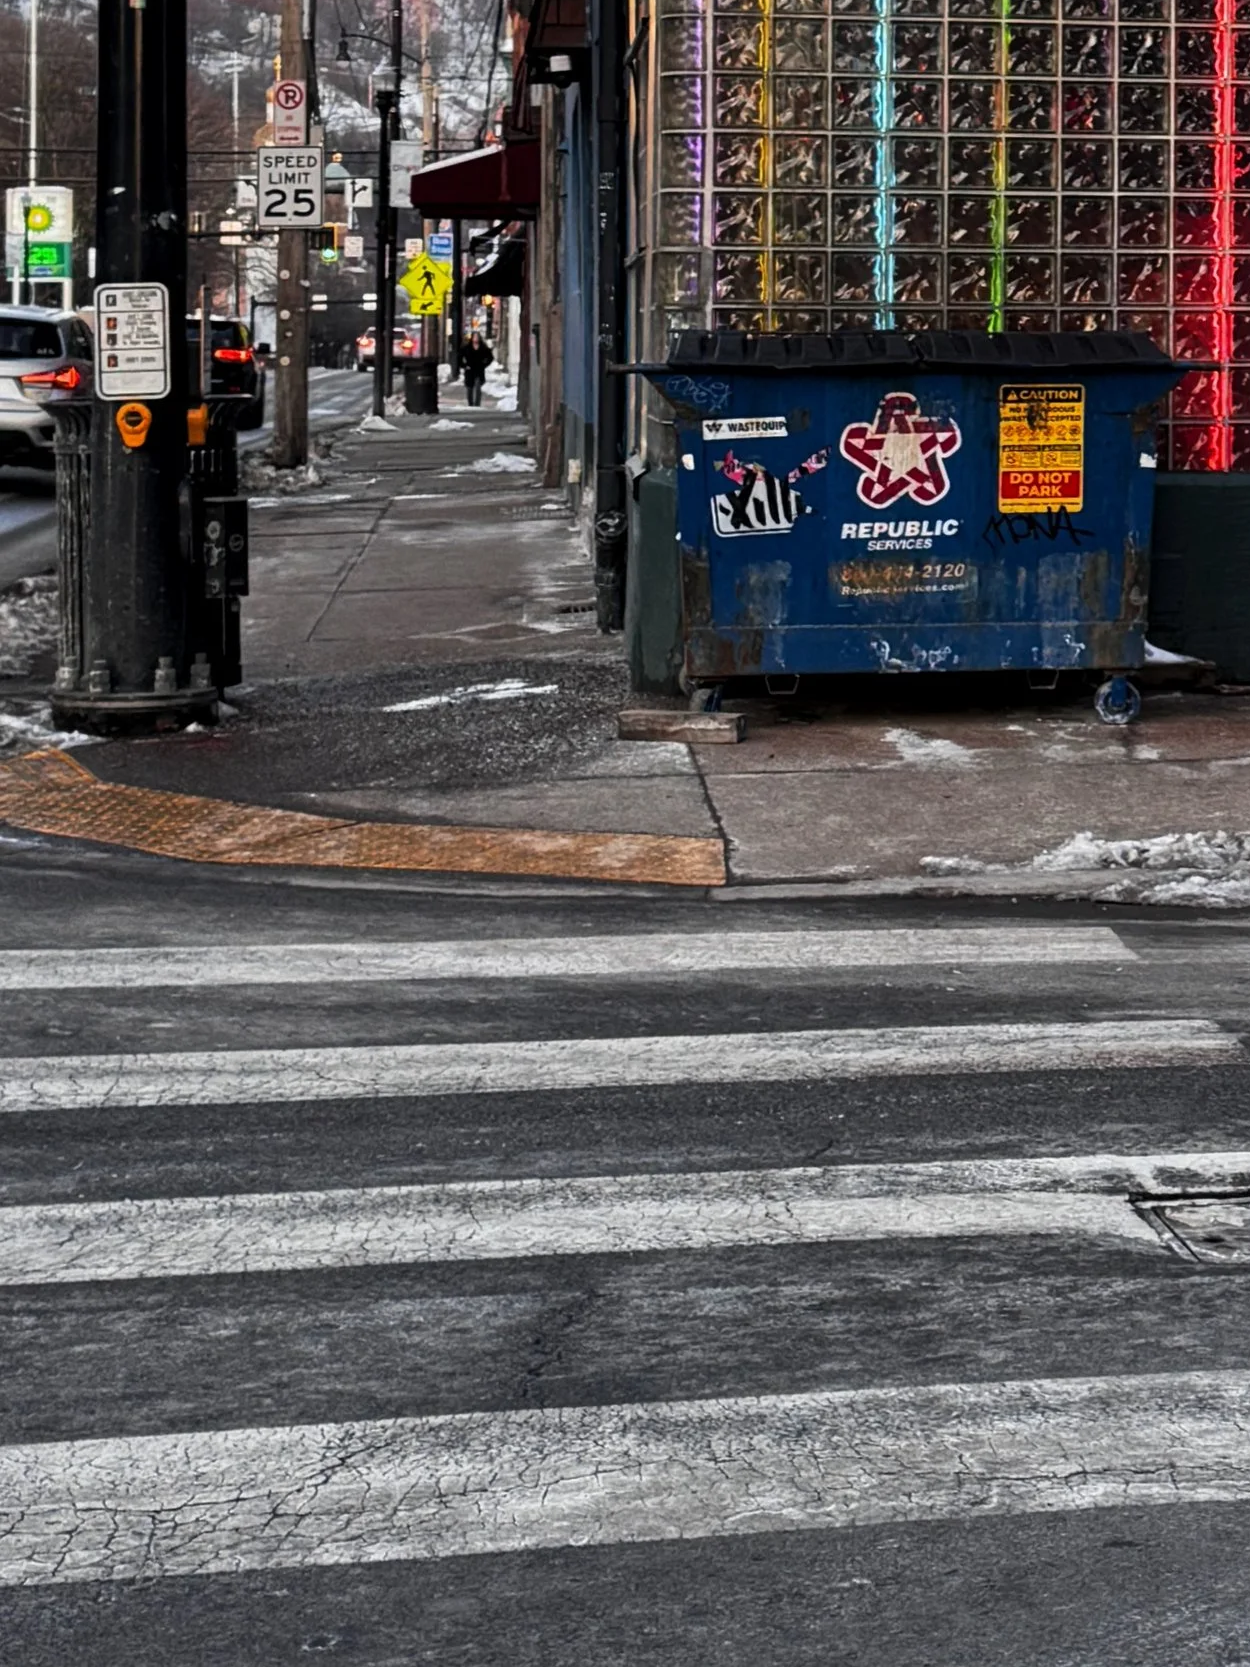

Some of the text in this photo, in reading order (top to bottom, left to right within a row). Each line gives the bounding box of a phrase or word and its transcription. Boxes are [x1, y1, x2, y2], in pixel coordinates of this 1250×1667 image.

[263, 156, 318, 168] SPEED
[268, 172, 311, 185] LIMIT
[264, 189, 316, 217] 25
[1020, 389, 1079, 400] CAUTION
[727, 421, 787, 433] WASTEQUIP
[1010, 472, 1073, 484] DO NOT
[1018, 485, 1063, 497] PARK
[841, 519, 960, 540] REPUBLIC
[867, 538, 933, 551] SERVICES
